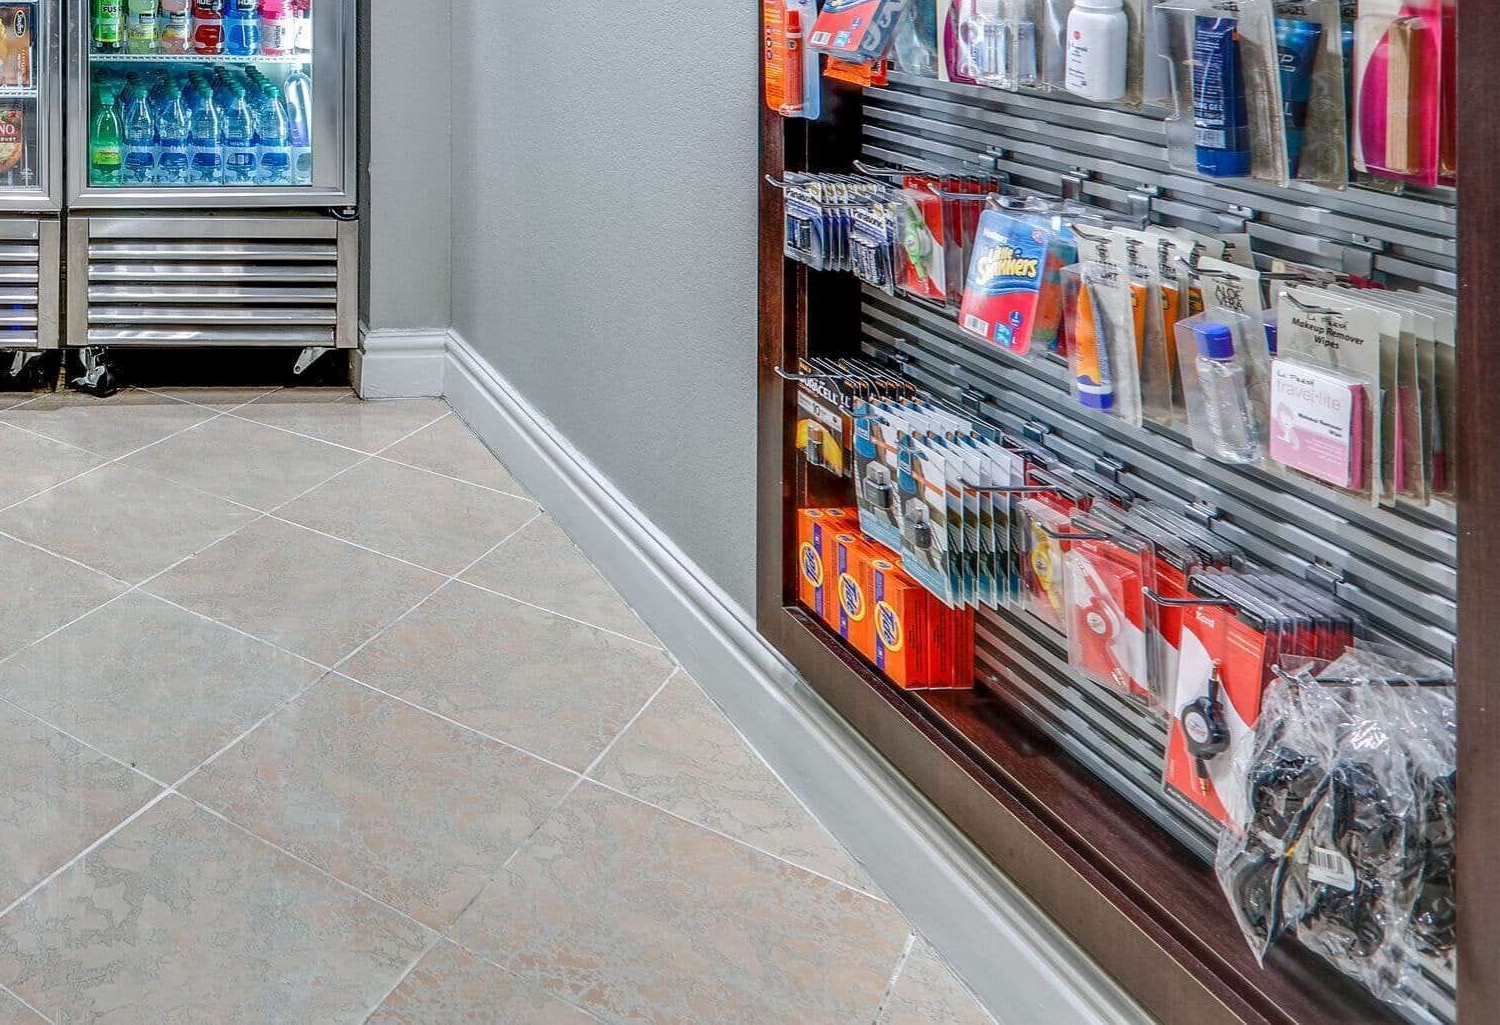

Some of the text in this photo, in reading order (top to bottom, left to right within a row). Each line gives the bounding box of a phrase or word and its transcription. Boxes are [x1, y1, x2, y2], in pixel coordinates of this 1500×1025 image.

[1215, 284, 1240, 298] ALOE
[1291, 317, 1365, 346] Makeup Remover
[1314, 335, 1340, 350] Wipes
